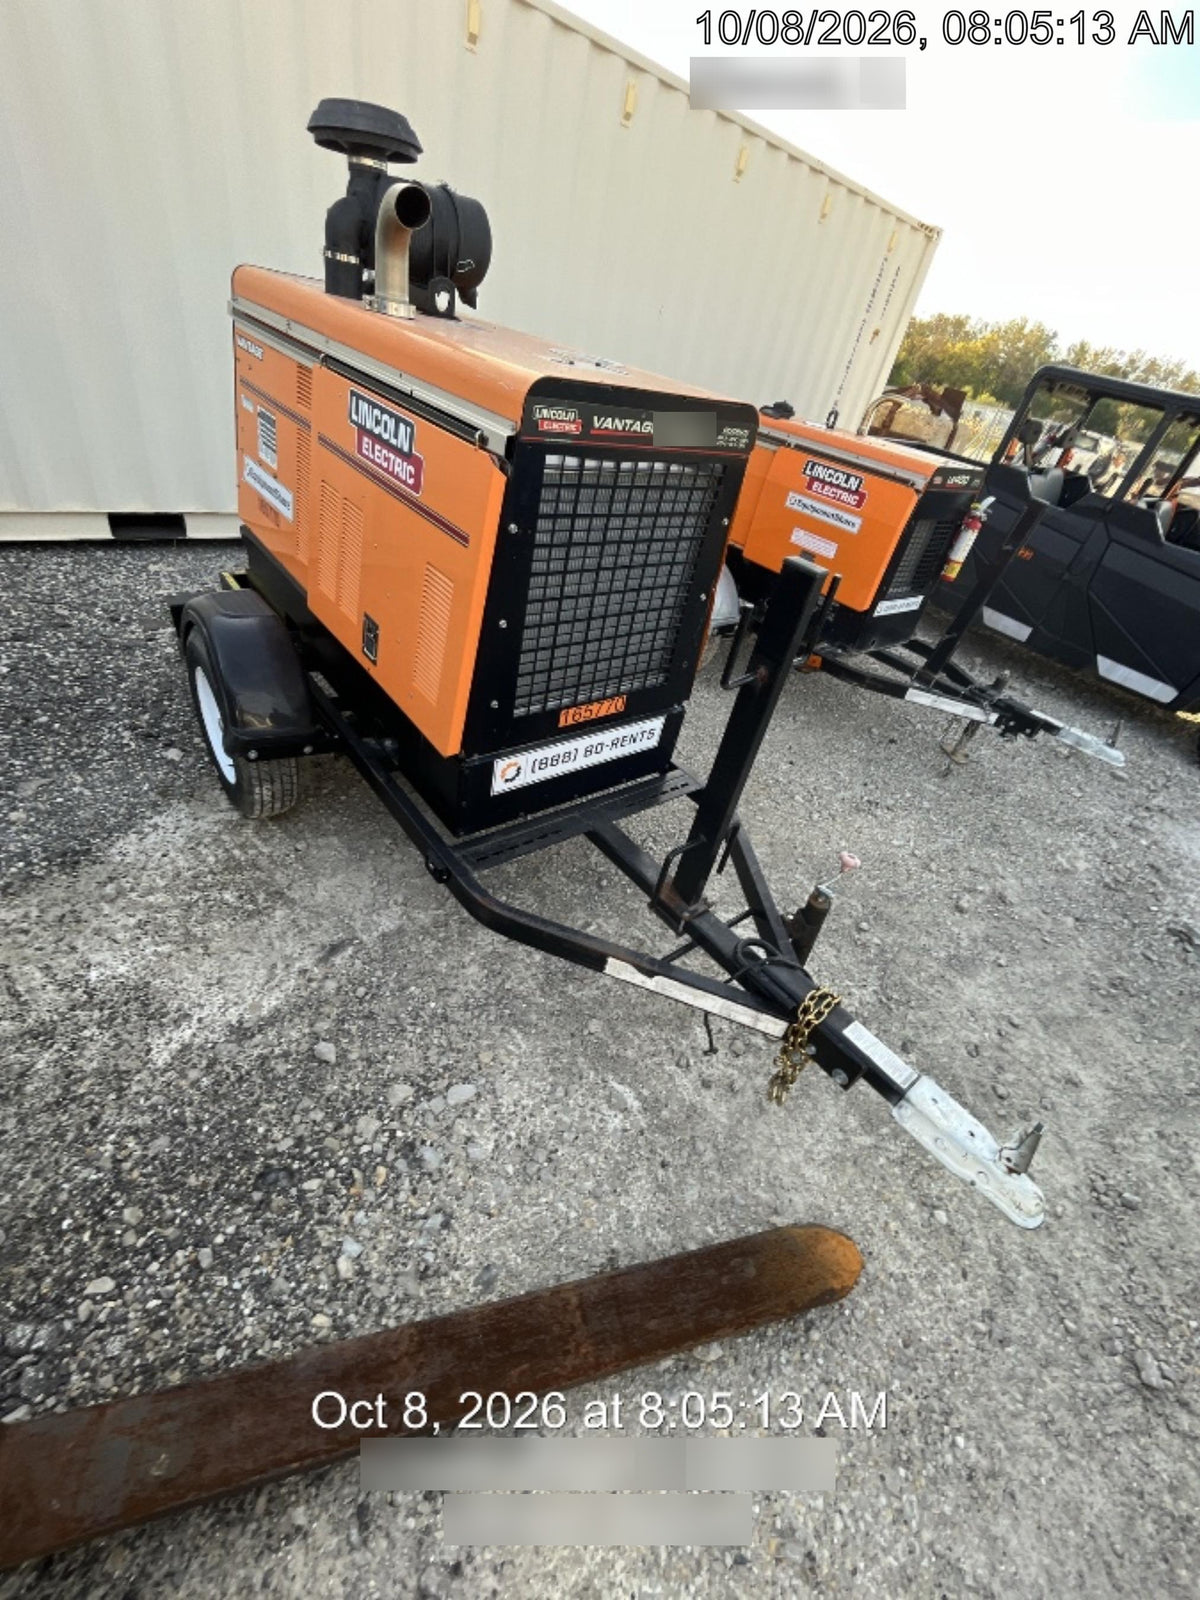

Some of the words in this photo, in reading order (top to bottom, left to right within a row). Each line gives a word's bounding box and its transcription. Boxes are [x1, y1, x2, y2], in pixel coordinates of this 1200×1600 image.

[351, 395, 411, 453] LINCOLN
[535, 407, 576, 422] LINCOLN
[361, 436, 415, 485] ELECTRIC
[804, 461, 860, 491] LINCOLN
[811, 481, 859, 506] ELECTRIC
[562, 695, 626, 724] 165770
[530, 748, 579, 774] (888)
